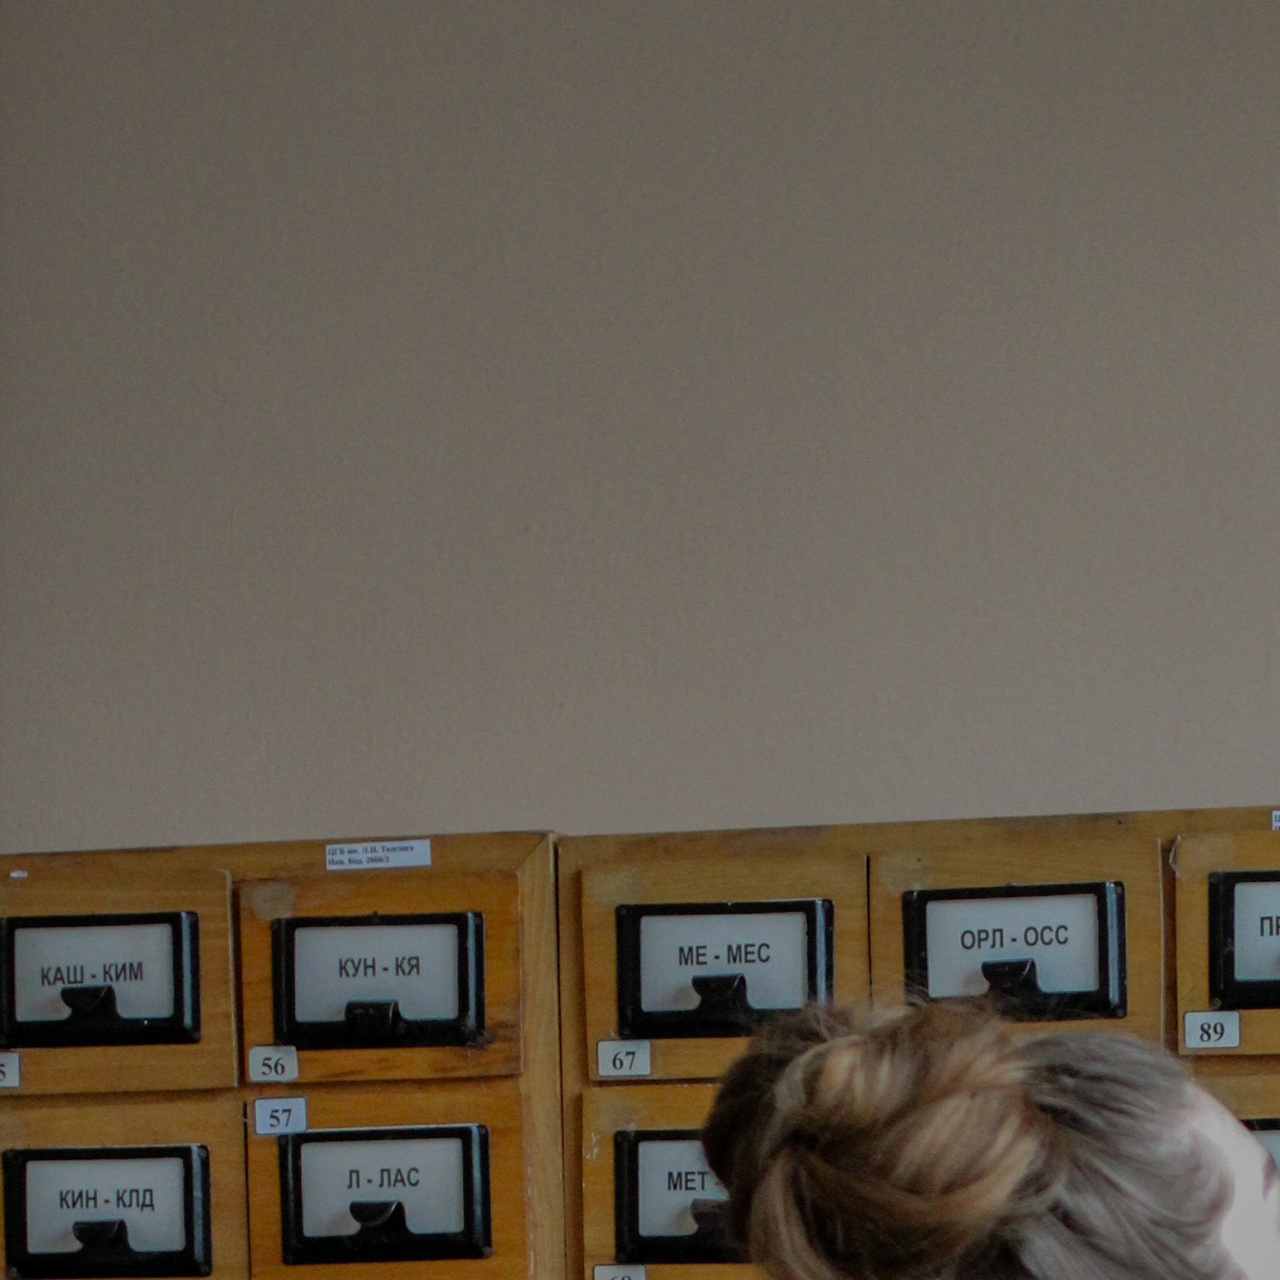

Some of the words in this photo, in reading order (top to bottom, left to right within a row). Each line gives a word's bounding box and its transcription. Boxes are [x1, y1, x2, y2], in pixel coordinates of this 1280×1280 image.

[961, 929, 1003, 950] ОРЛ
[1024, 925, 1068, 946] ОСС
[679, 946, 707, 965] МЕ
[727, 943, 770, 963] МЕС
[41, 967, 83, 985] КАШ
[103, 962, 143, 982] КИМ
[339, 958, 375, 977] КУН
[395, 956, 420, 975] КЯ
[1200, 1023, 1224, 1041] 89
[262, 1057, 285, 1075] 56
[612, 1051, 636, 1069] 67
[270, 1109, 291, 1127] 57
[347, 1170, 360, 1189] Л
[379, 1168, 419, 1188] ЛАС
[60, 1191, 97, 1209] КИН
[117, 1189, 154, 1211] КЛД
